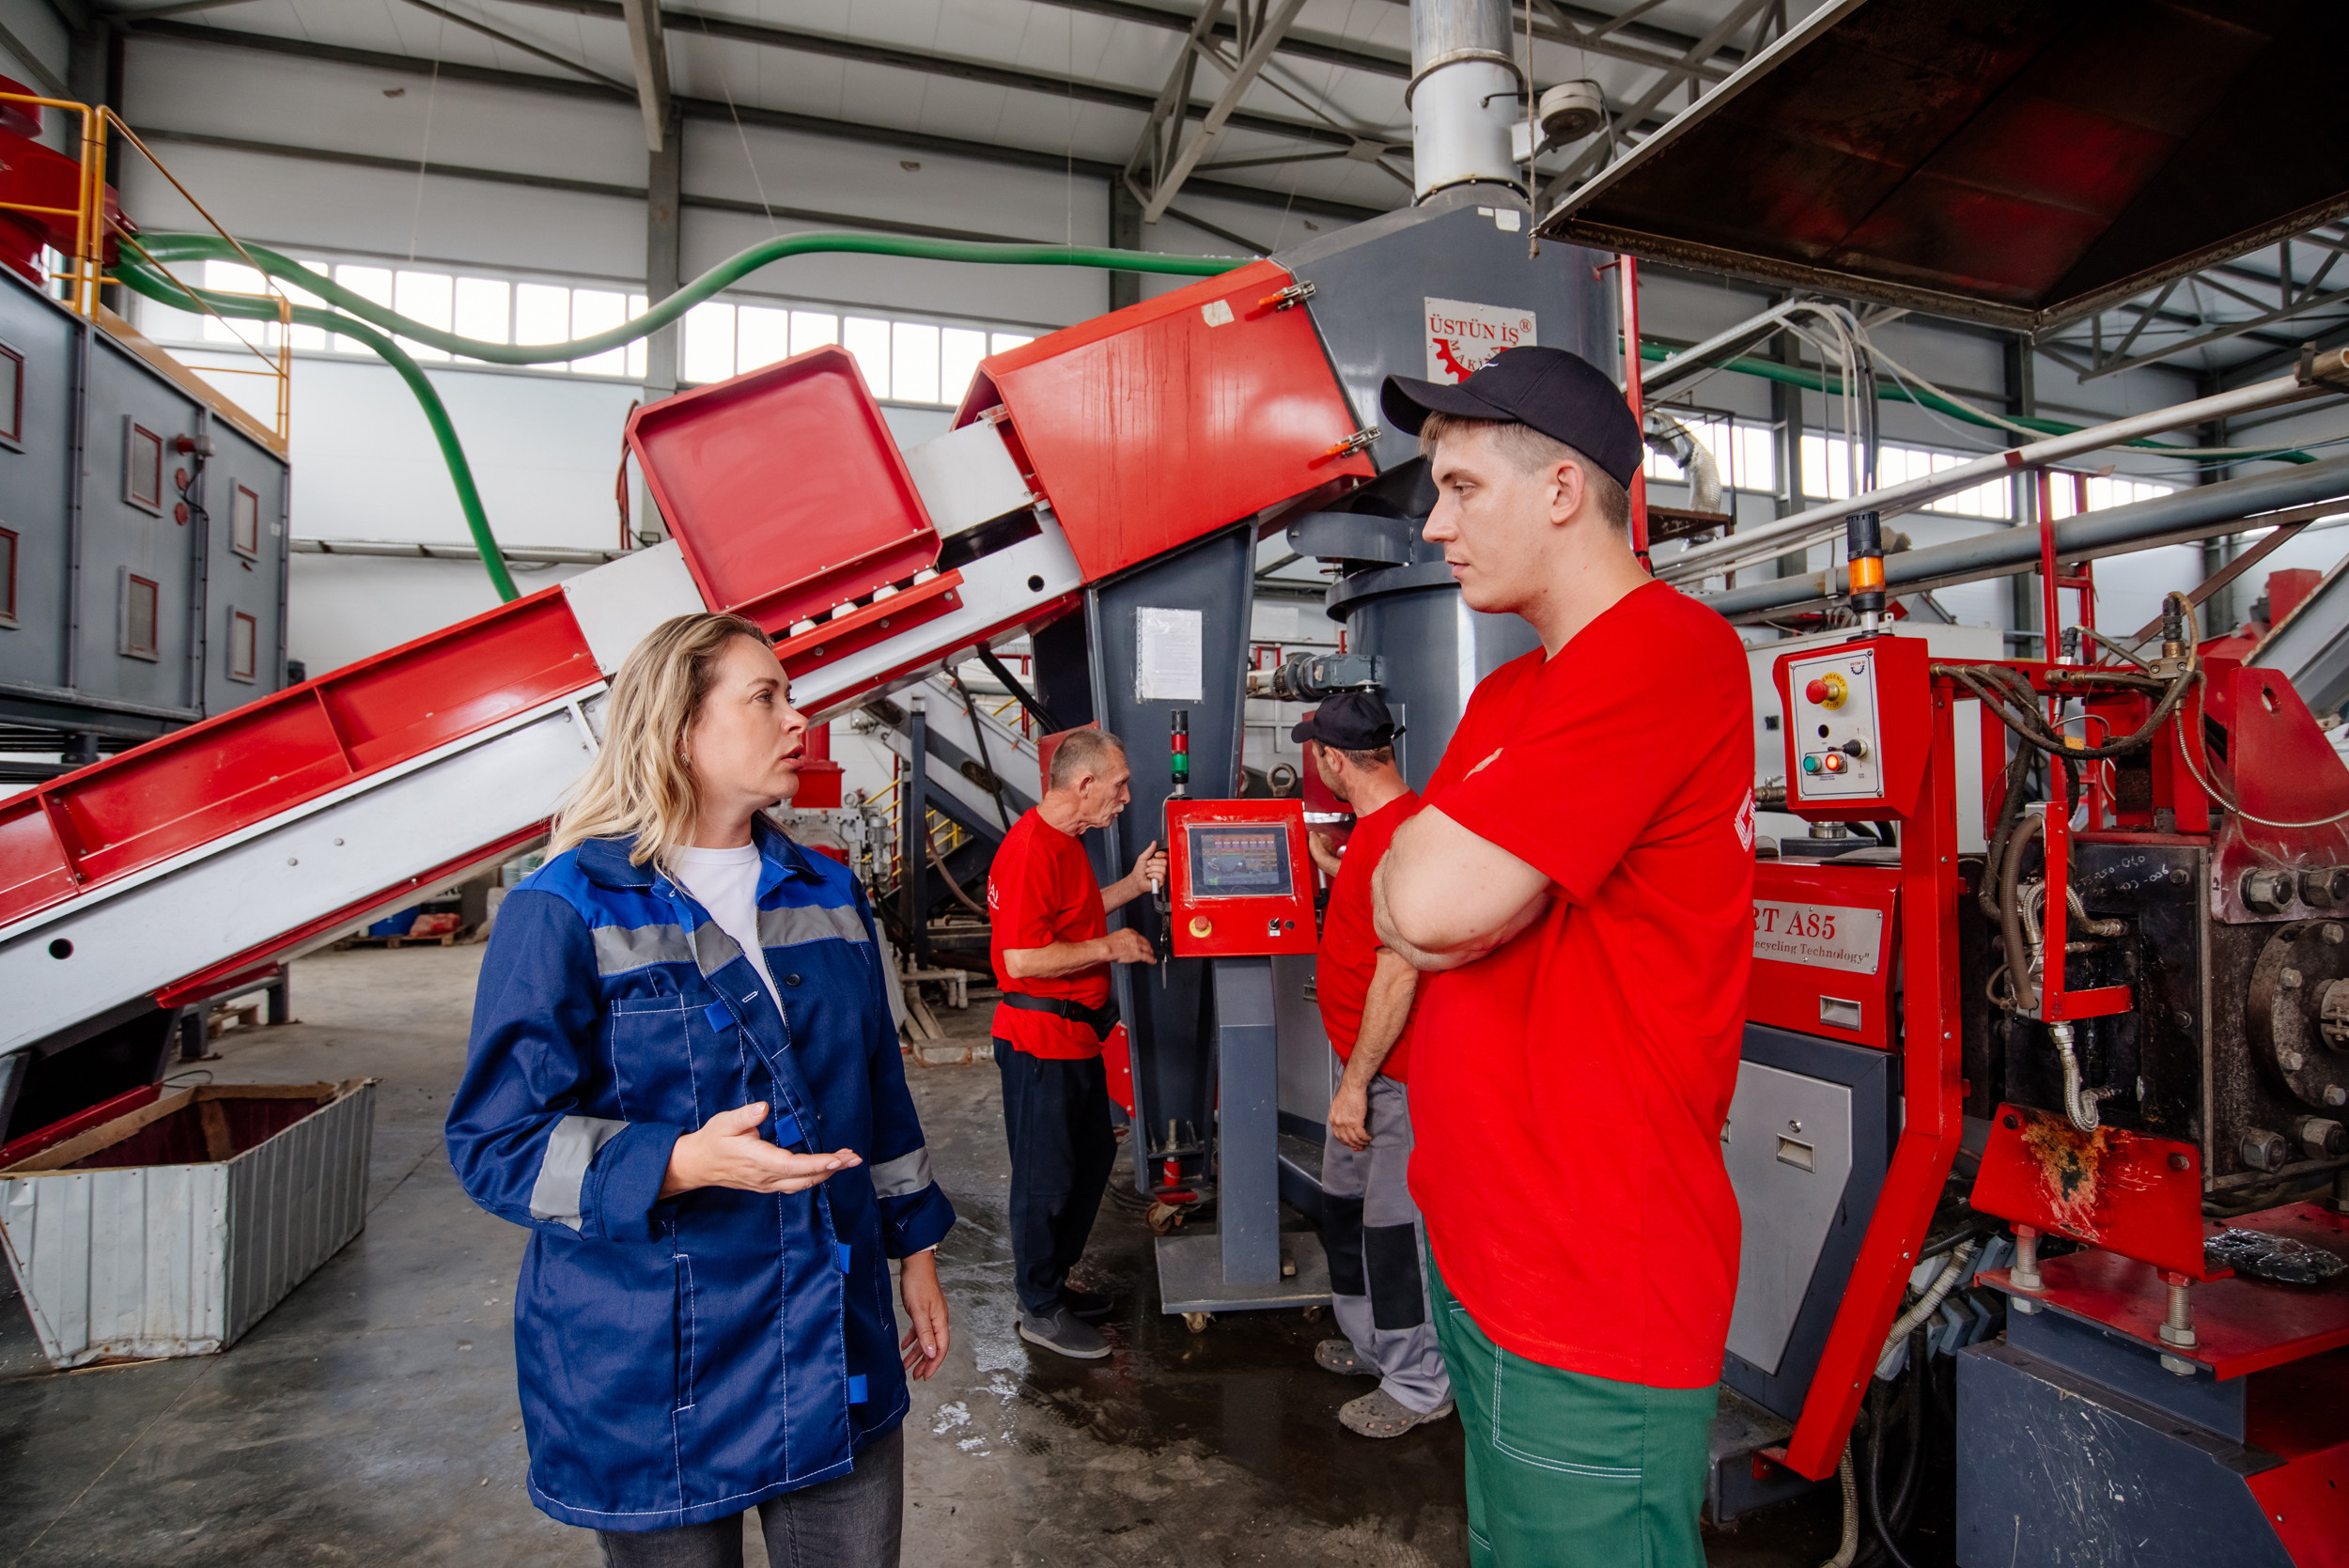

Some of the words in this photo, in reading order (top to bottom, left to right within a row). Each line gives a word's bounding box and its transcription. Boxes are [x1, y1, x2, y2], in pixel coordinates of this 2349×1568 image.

[1429, 314, 1496, 340] ÜSTÜN
[1821, 674, 1845, 687] ERGENCY
[1785, 910, 1836, 940] A85
[1753, 939, 1797, 955] ecycling
